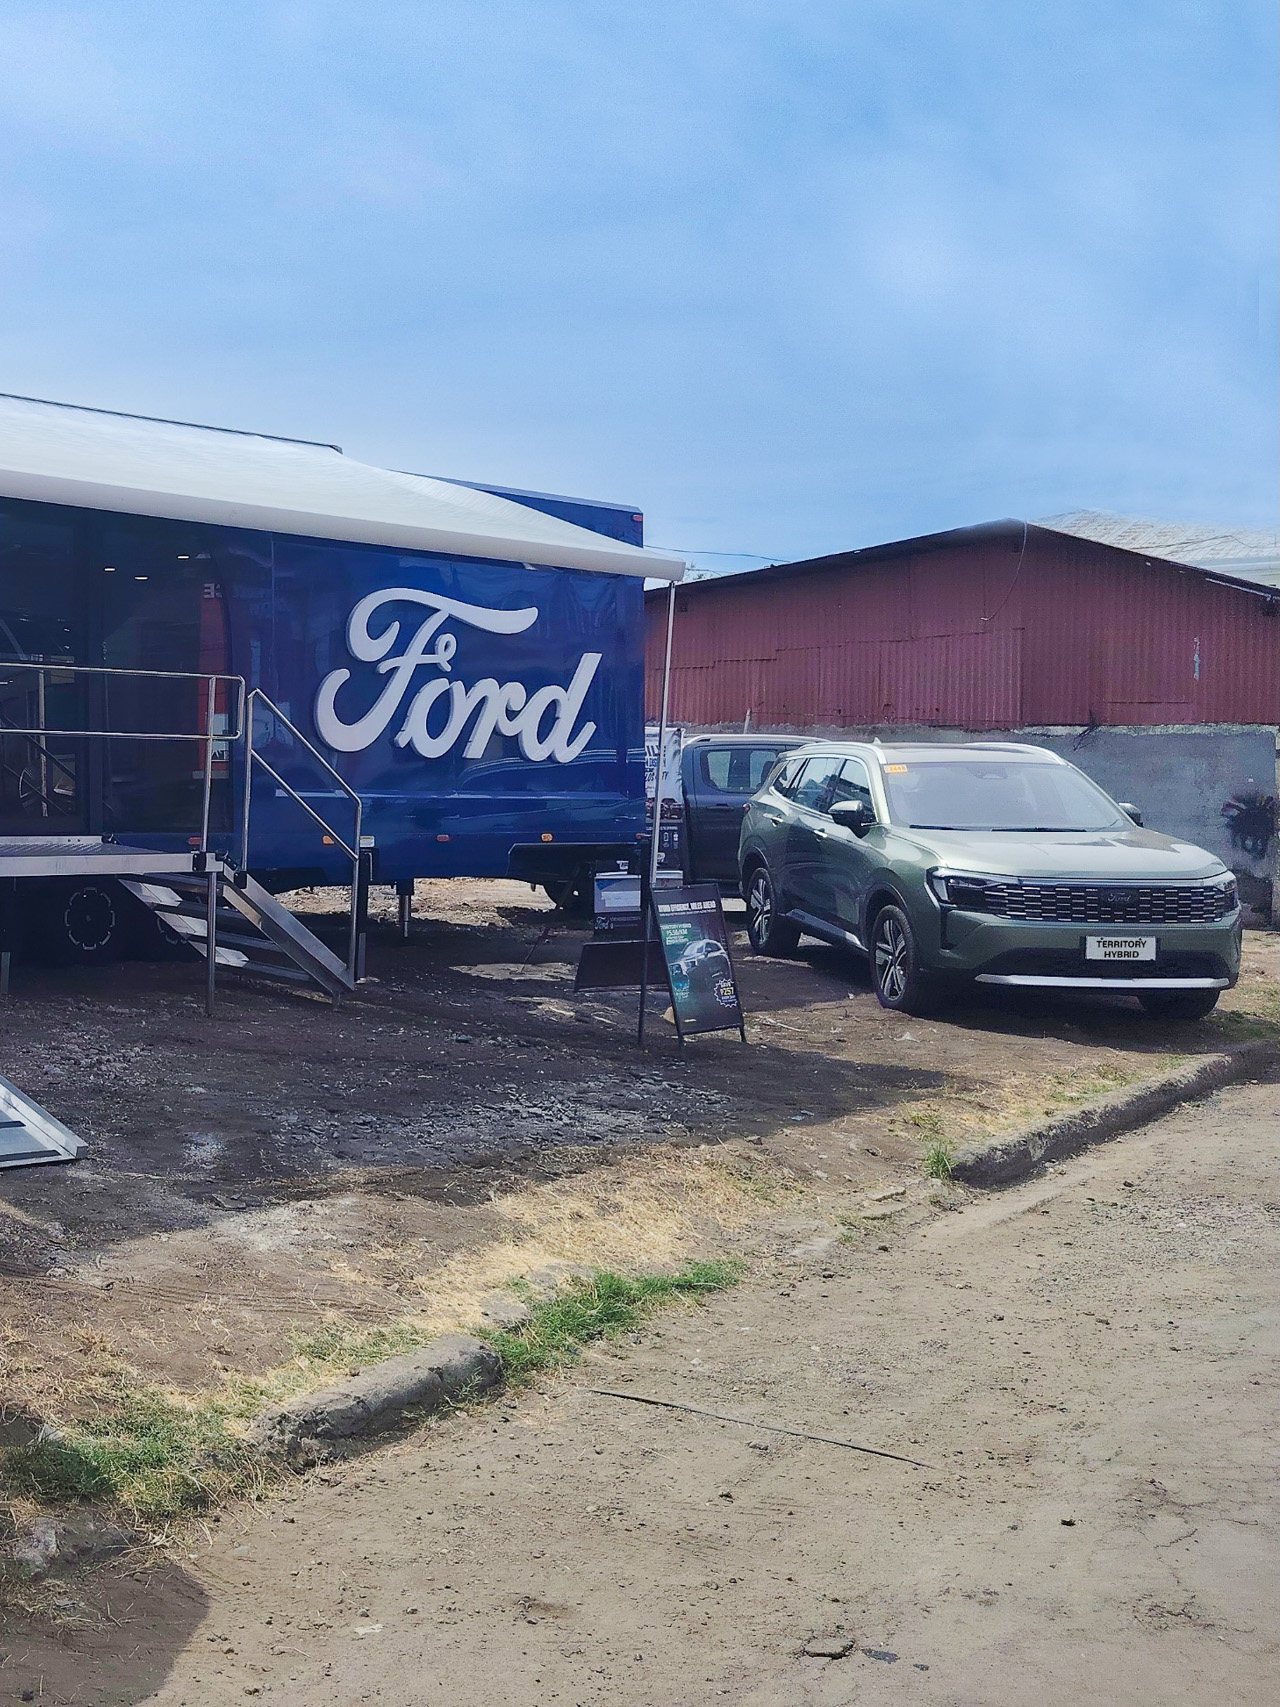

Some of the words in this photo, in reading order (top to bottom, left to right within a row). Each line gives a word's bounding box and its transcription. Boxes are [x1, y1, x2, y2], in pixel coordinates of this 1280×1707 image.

[316, 588, 602, 764] Ford
[1108, 892, 1131, 902] Ford
[1096, 940, 1147, 949] TERRITORY
[1104, 950, 1140, 959] HYBRID
